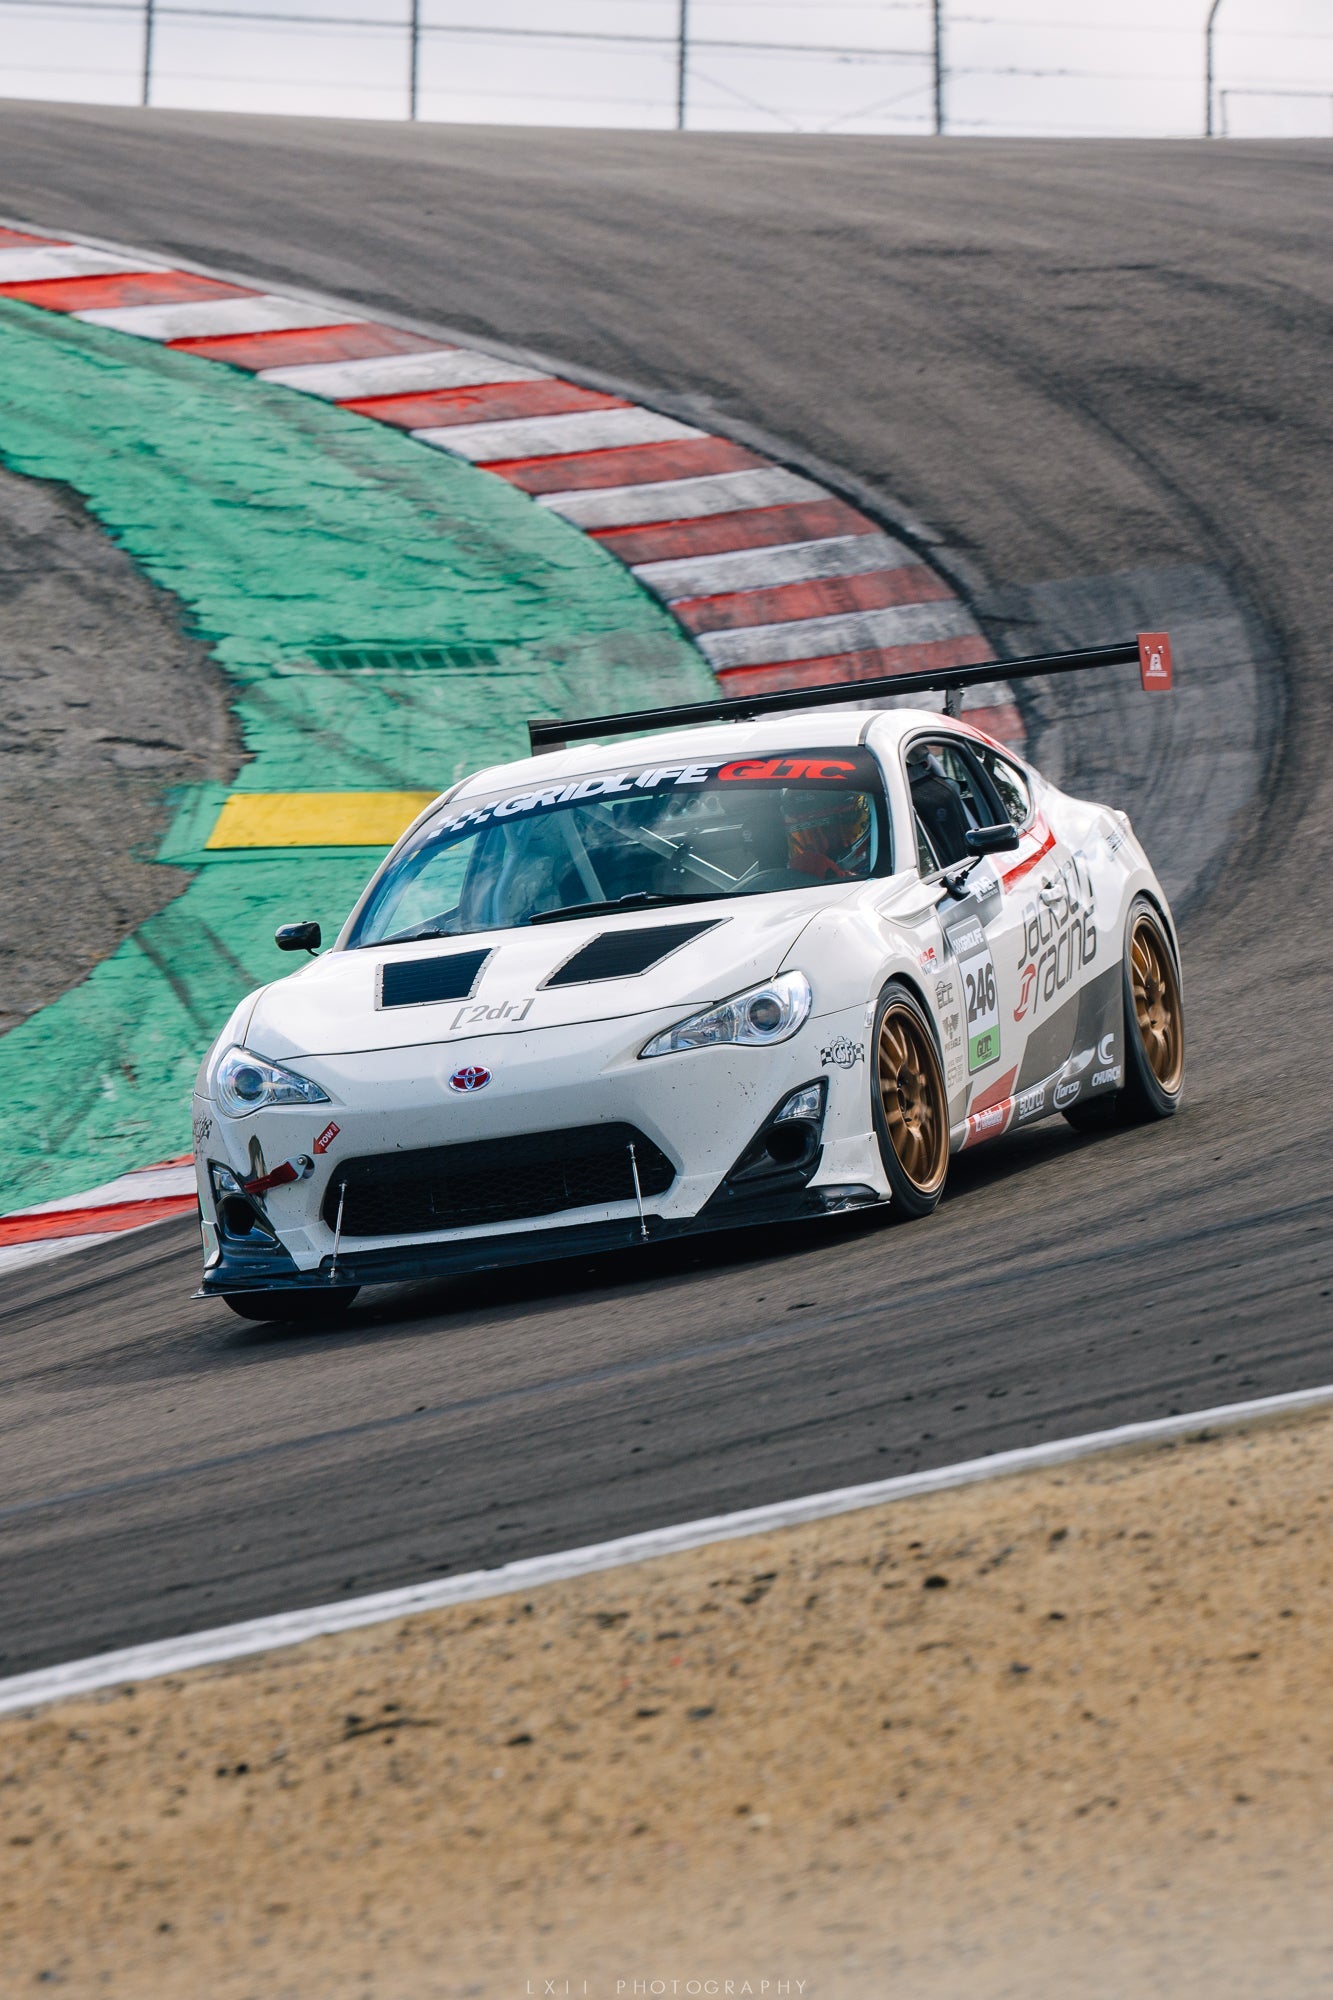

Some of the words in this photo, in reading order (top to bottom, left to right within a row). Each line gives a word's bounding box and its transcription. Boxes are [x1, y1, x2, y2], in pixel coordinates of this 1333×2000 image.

[493, 761, 727, 818] GRIDLIFE
[965, 962, 996, 1023] 246
[449, 998, 535, 1030] [2dr]
[1091, 1065, 1121, 1087] CHURCH
[318, 1128, 334, 1147] TOW
